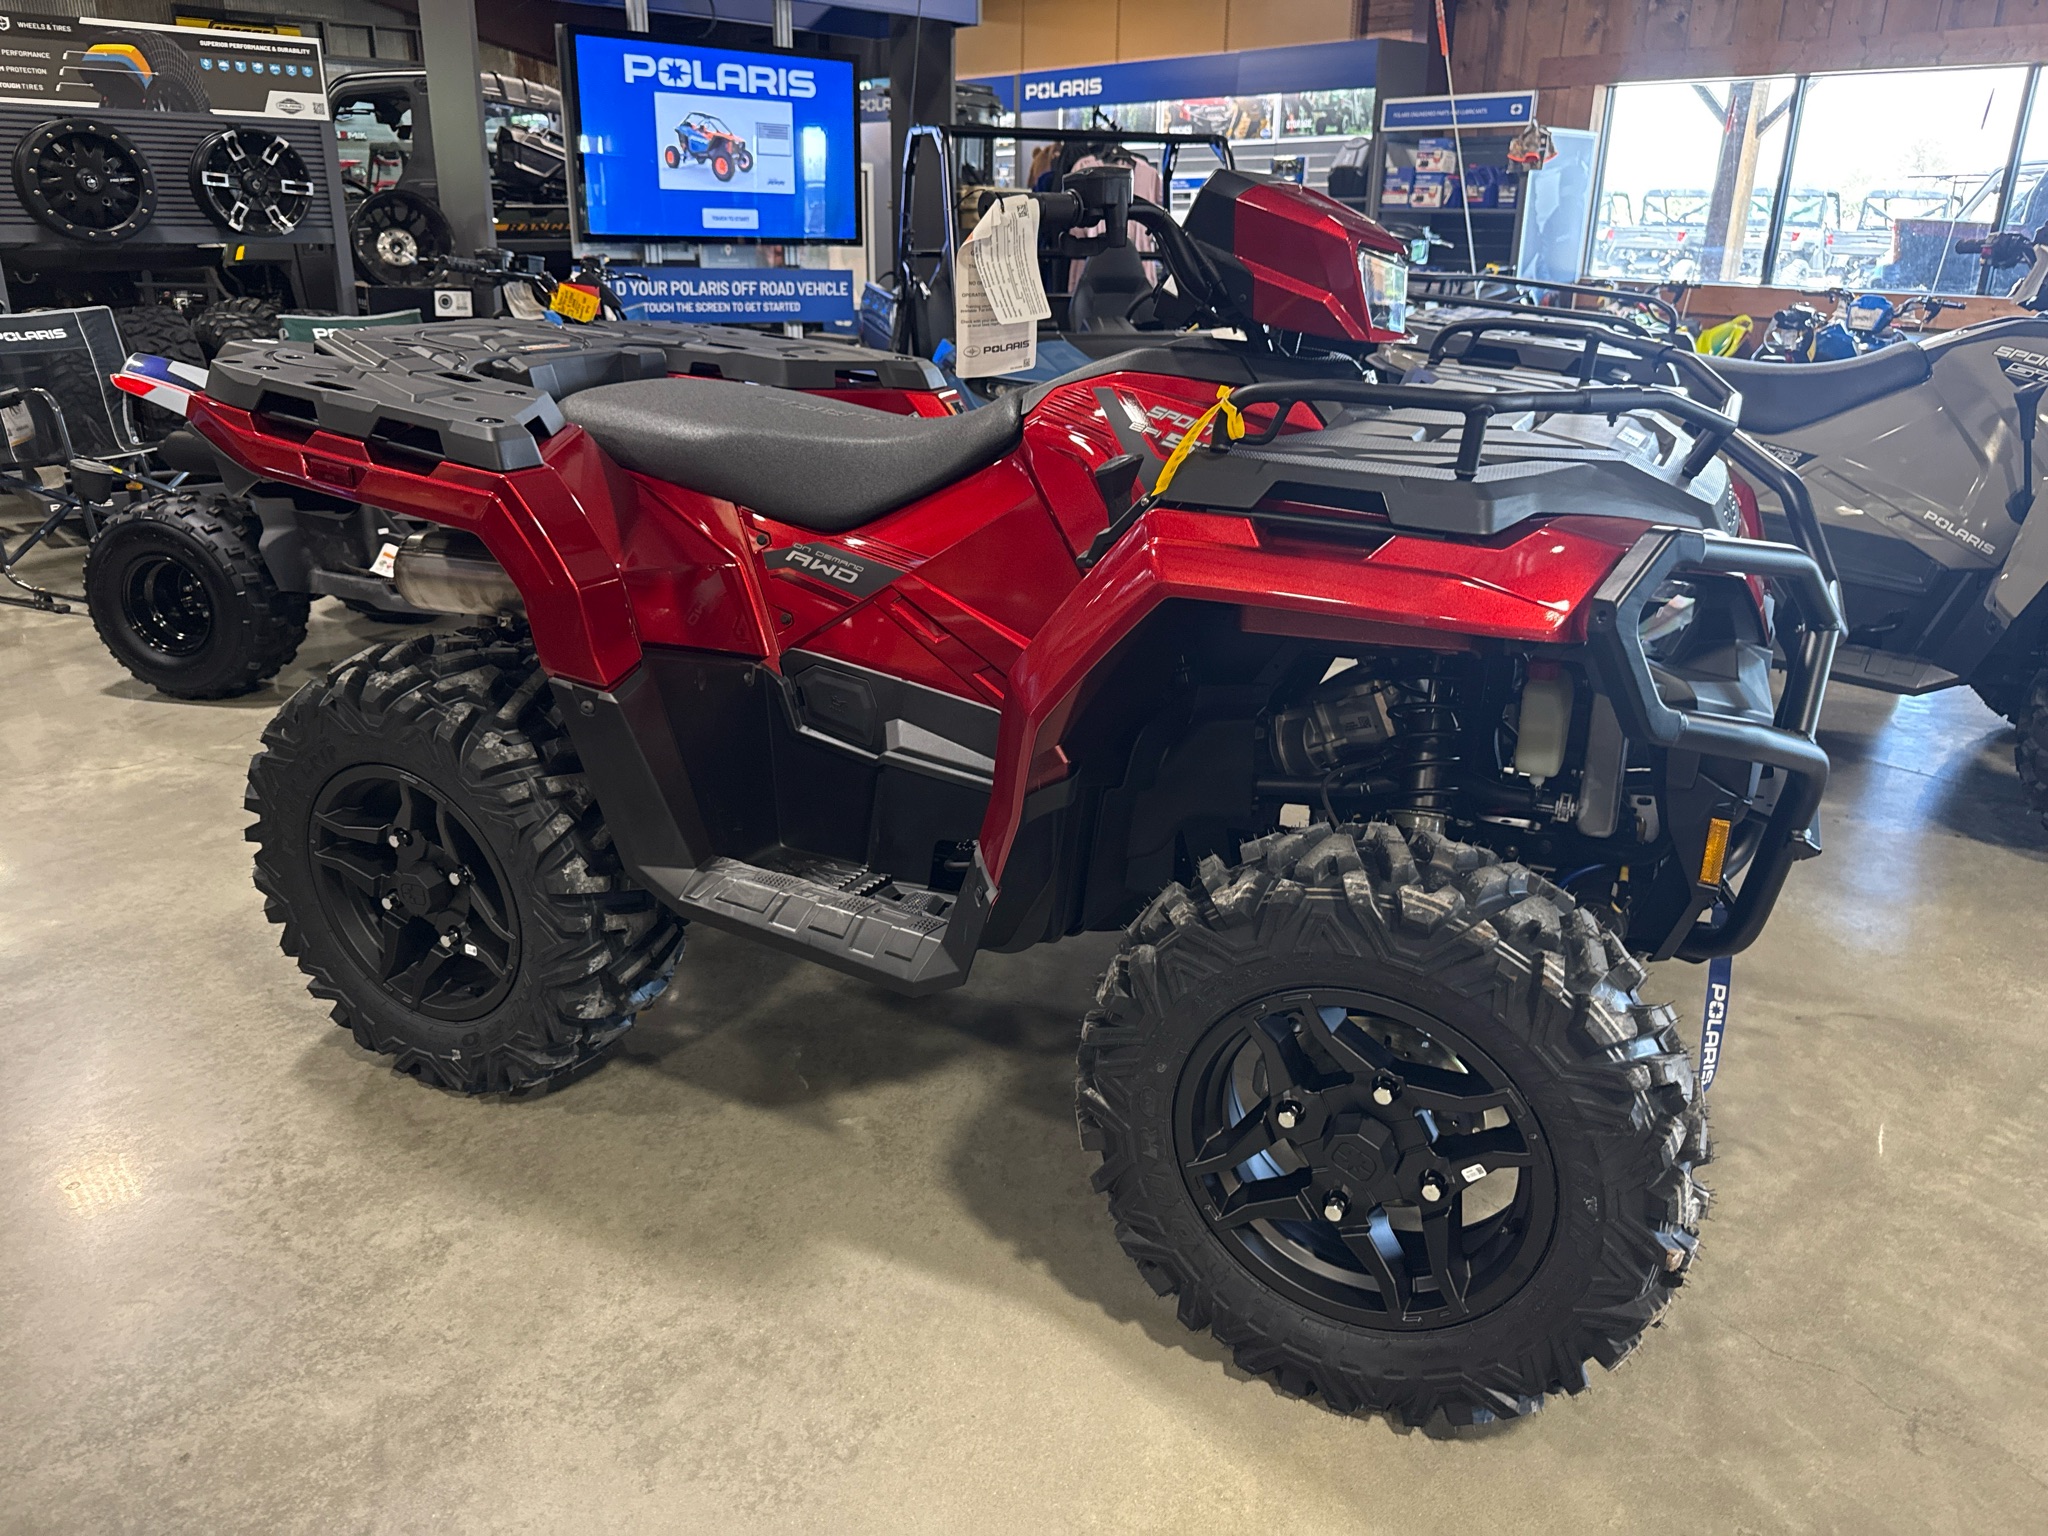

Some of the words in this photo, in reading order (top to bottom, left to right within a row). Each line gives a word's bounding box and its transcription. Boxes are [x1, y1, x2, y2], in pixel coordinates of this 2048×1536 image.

[17, 21, 46, 30] WHEELS
[53, 24, 72, 32] TIRES
[1, 48, 51, 59] PERFORMANCE
[199, 40, 229, 49] SUPERIOR
[229, 42, 271, 52] PERFORMANCE
[277, 47, 311, 55] DURABILITY
[6, 66, 47, 75] PROTECTION
[623, 53, 817, 99] POLARIS
[22, 83, 44, 91] TIRES
[1025, 77, 1103, 101] POLARIS
[629, 280, 668, 297] YOUR
[670, 280, 730, 296] POLARIS
[732, 281, 757, 297] OFF
[760, 281, 795, 297] ROAD
[796, 281, 849, 297] VEHICLE
[643, 302, 674, 313] TOUCH
[677, 301, 694, 312] THE
[695, 302, 731, 313] SCREEN
[731, 302, 744, 312] TO
[745, 302, 762, 313] GET
[763, 302, 801, 313] STARTED
[0, 328, 67, 341] OLARIS
[983, 339, 1030, 354] POLARIS
[1129, 422, 1162, 438] EFI
[1923, 510, 1996, 555] POLARIS
[793, 542, 812, 553] ON
[815, 550, 865, 573] DEMAND
[785, 550, 859, 584] AWD
[1701, 983, 1727, 1086] POLARIS
